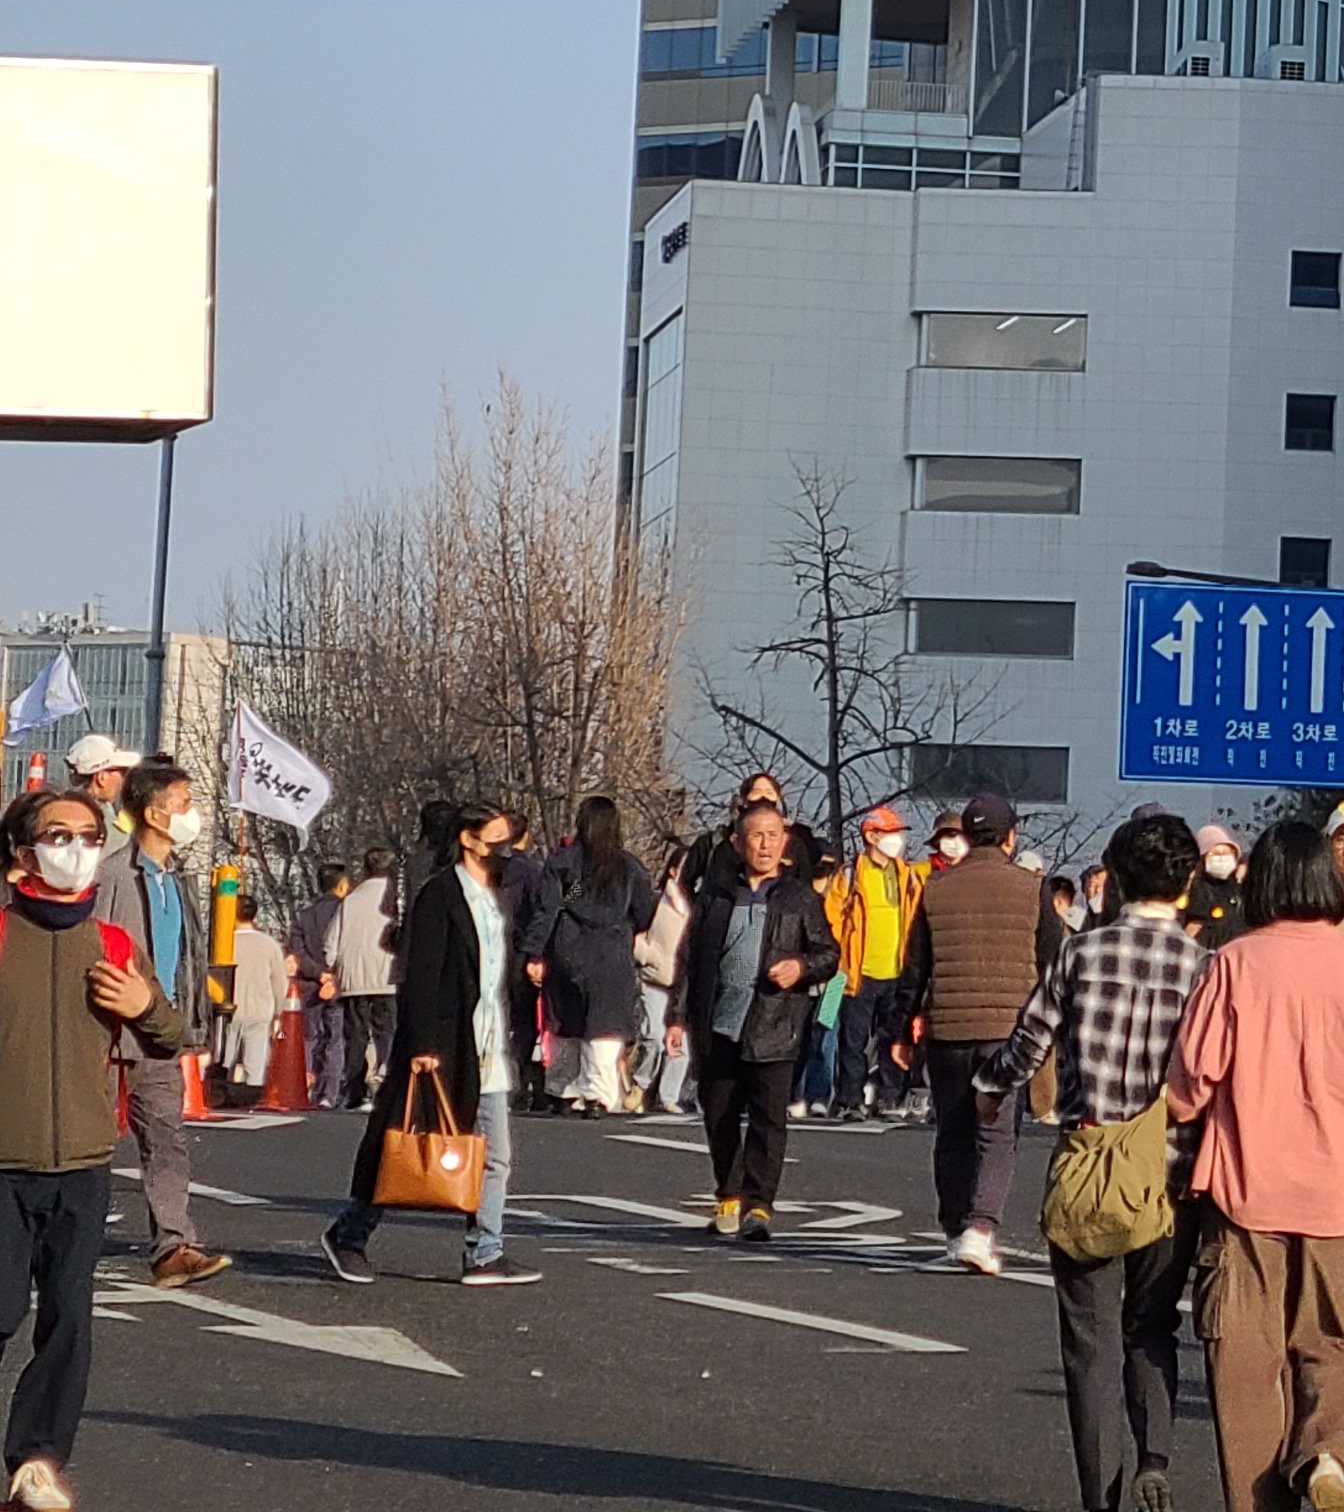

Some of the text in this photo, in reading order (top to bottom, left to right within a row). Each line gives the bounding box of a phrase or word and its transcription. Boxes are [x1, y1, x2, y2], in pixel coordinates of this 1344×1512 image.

[1153, 716, 1199, 738] 1차로
[1225, 719, 1272, 741] 2차로
[1292, 722, 1338, 743] 3차로
